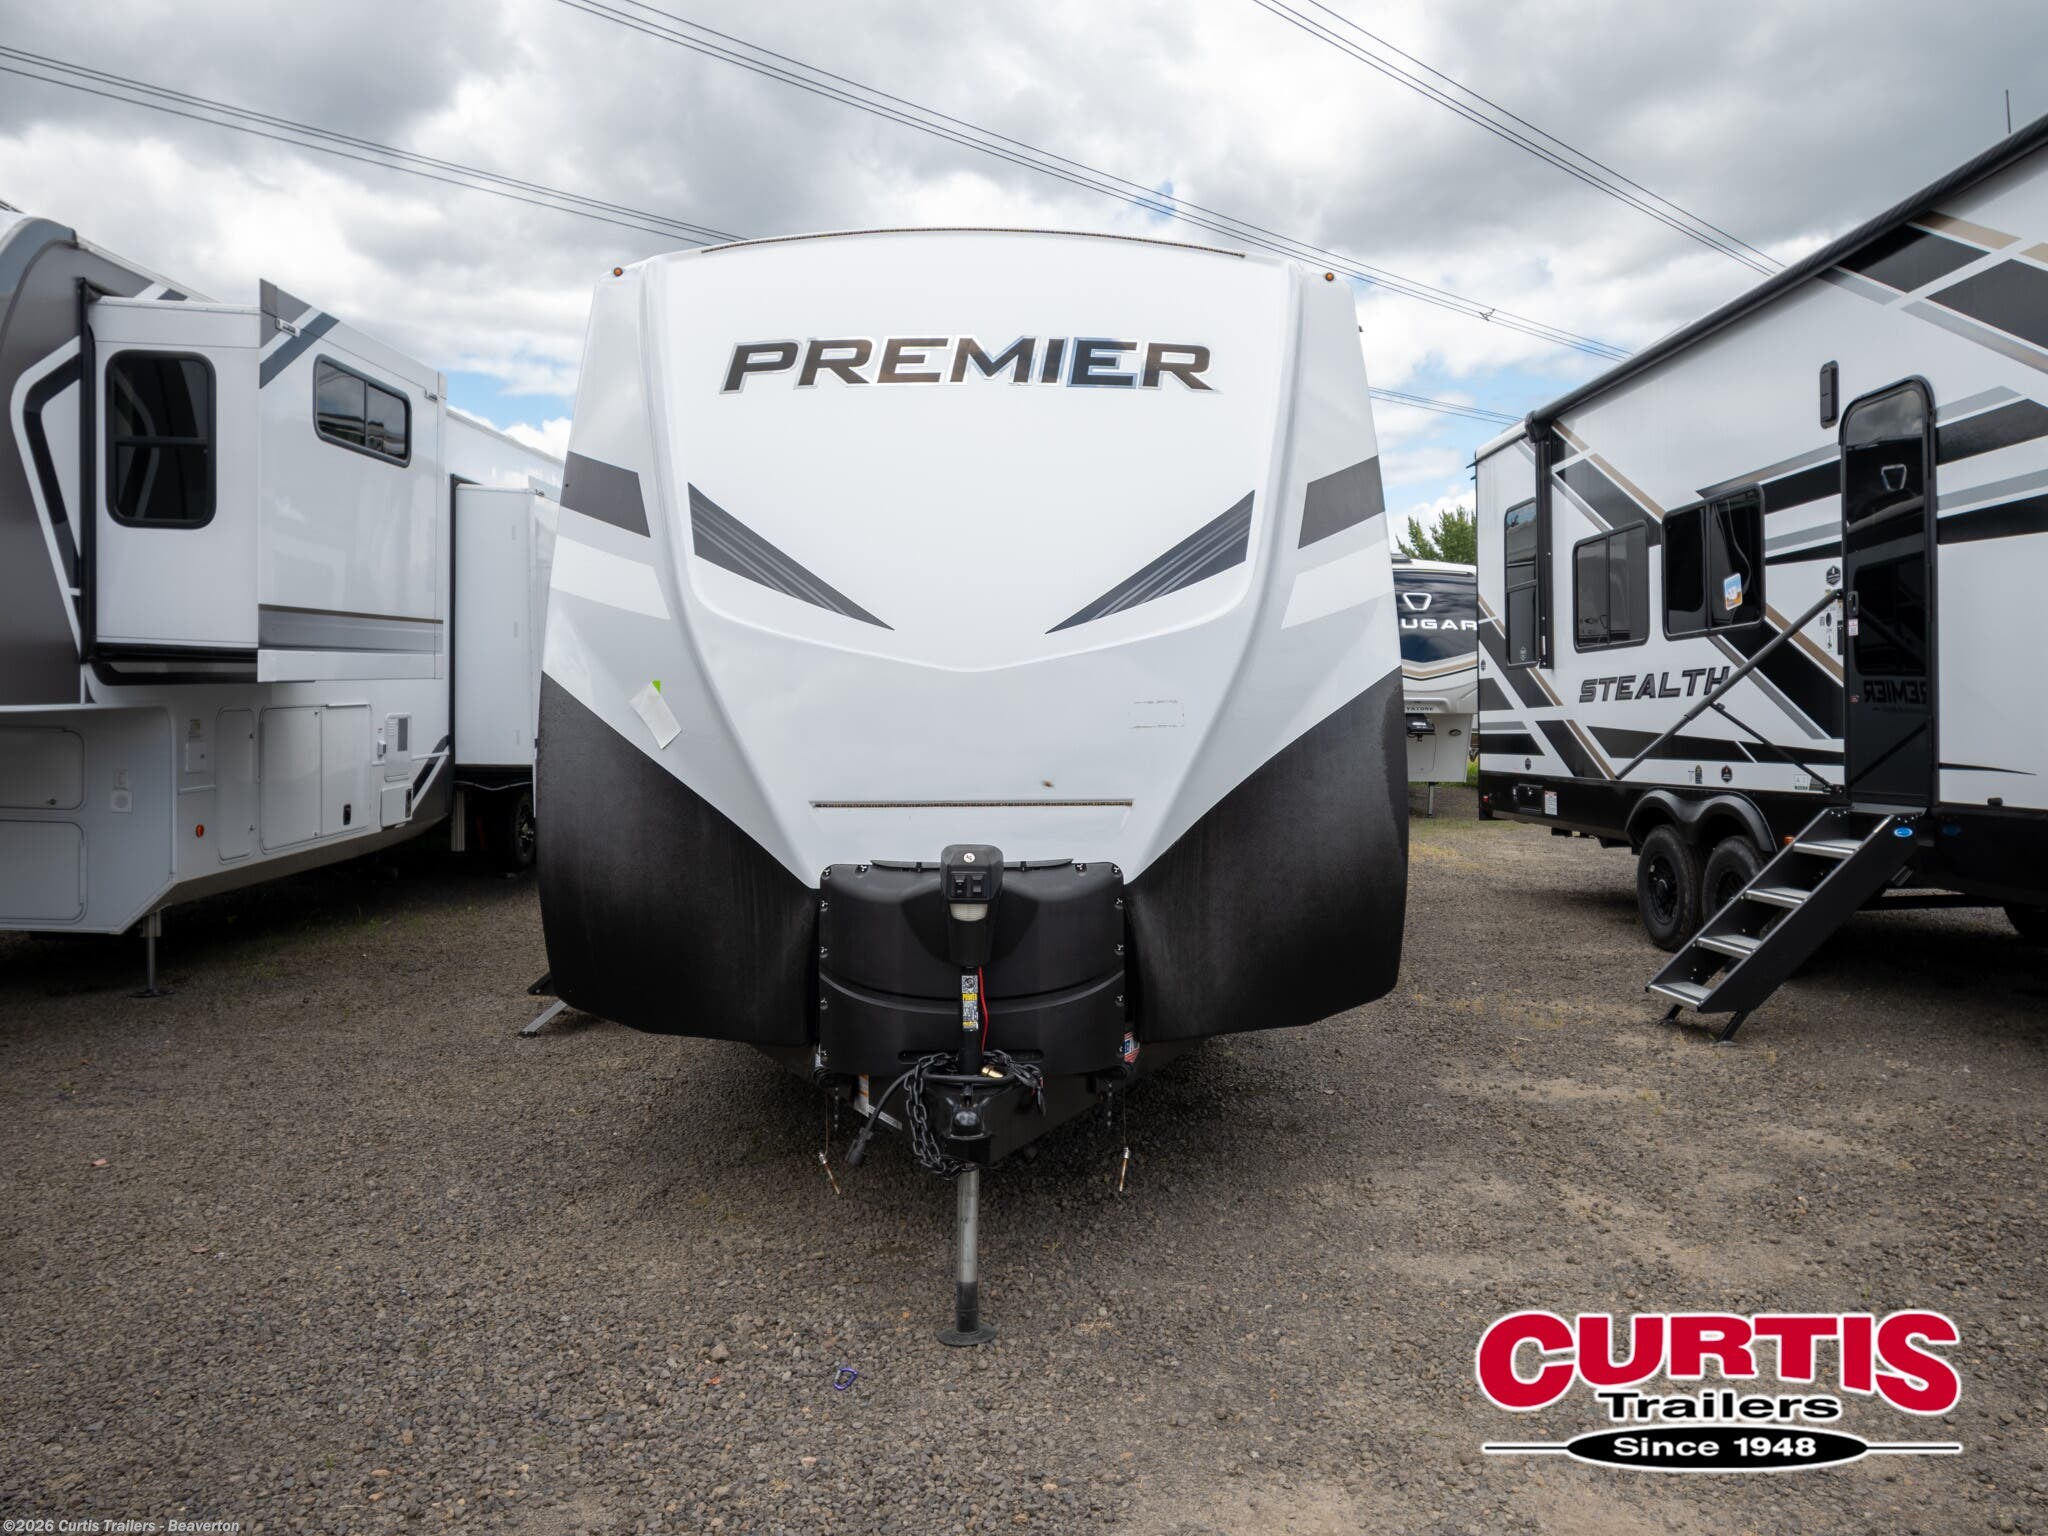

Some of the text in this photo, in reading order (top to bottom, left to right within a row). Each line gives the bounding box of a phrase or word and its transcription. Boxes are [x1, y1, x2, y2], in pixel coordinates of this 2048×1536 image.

[720, 336, 1222, 394] PREMIER
[1401, 618, 1477, 631] UGAR
[1579, 666, 1730, 703] STEALTH
